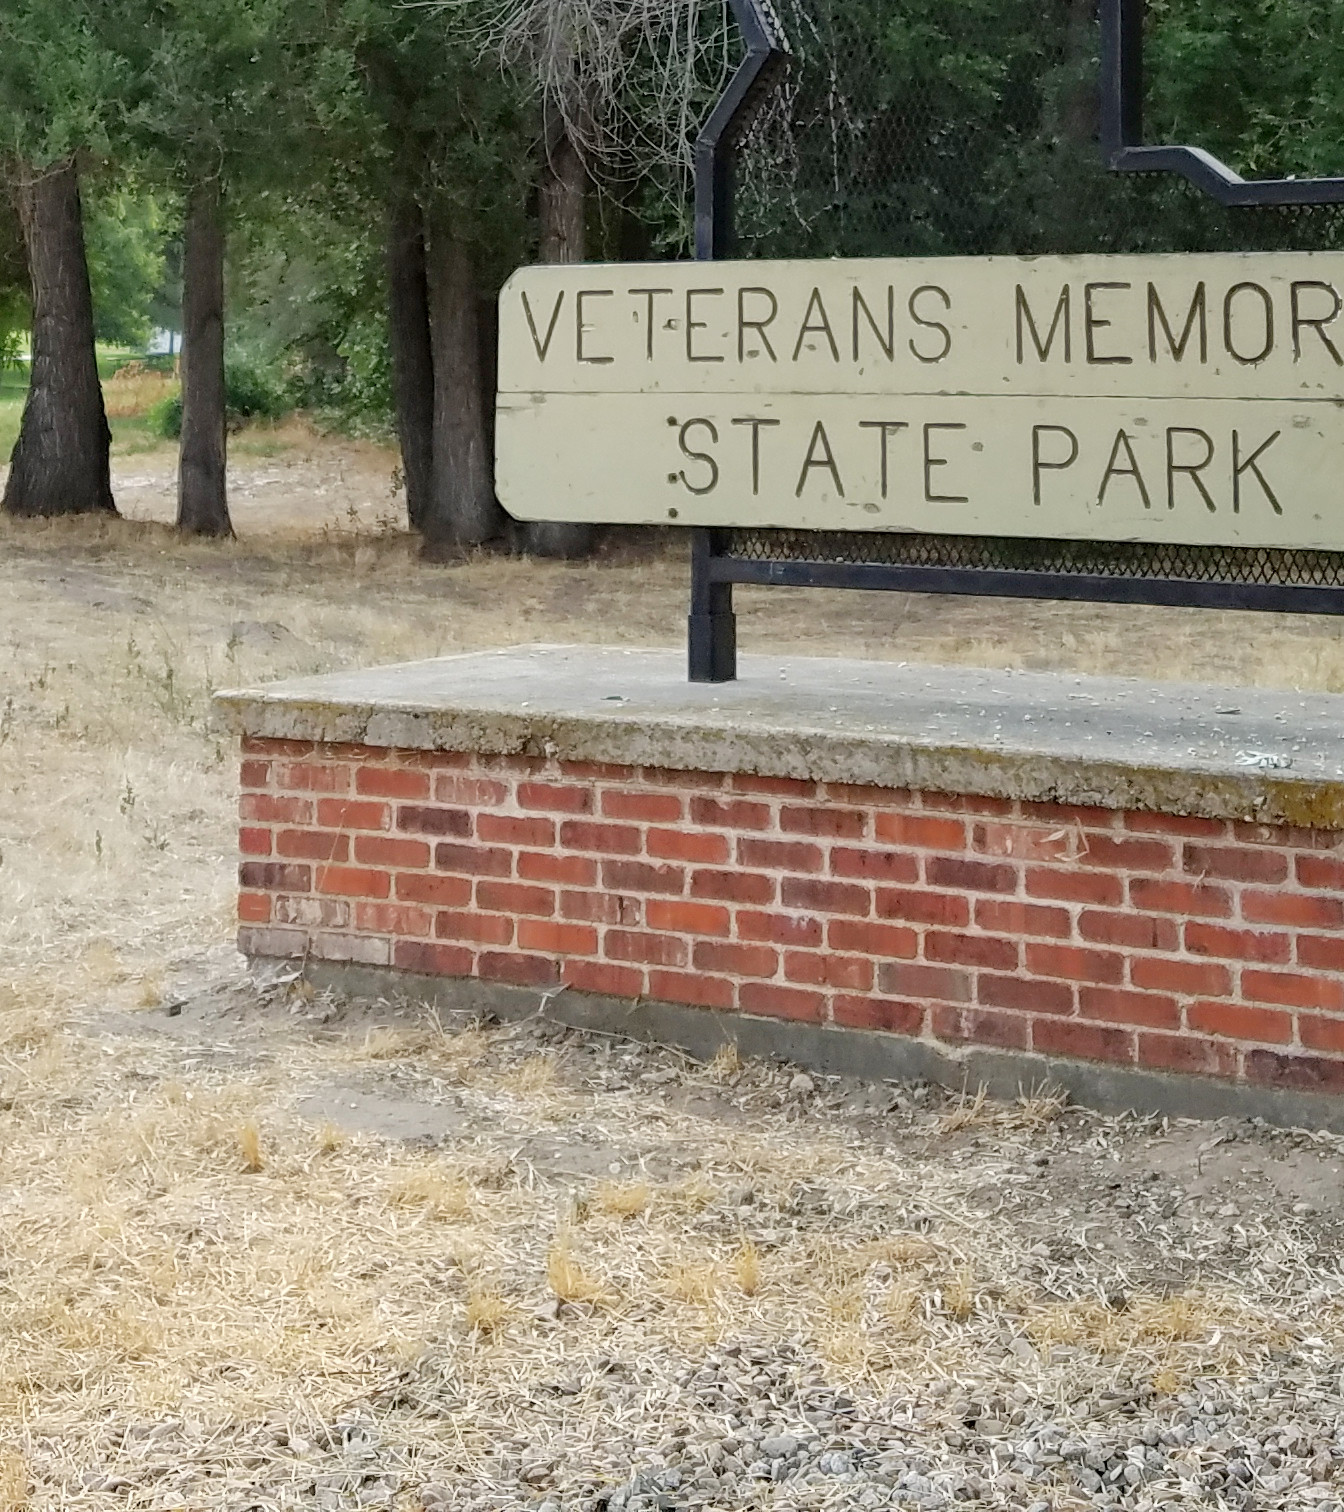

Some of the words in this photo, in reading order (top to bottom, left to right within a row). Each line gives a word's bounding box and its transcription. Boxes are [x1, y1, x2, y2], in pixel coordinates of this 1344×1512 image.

[520, 284, 953, 364] VETERANS
[677, 417, 969, 503] STATE
[1030, 424, 1283, 515] PARK
